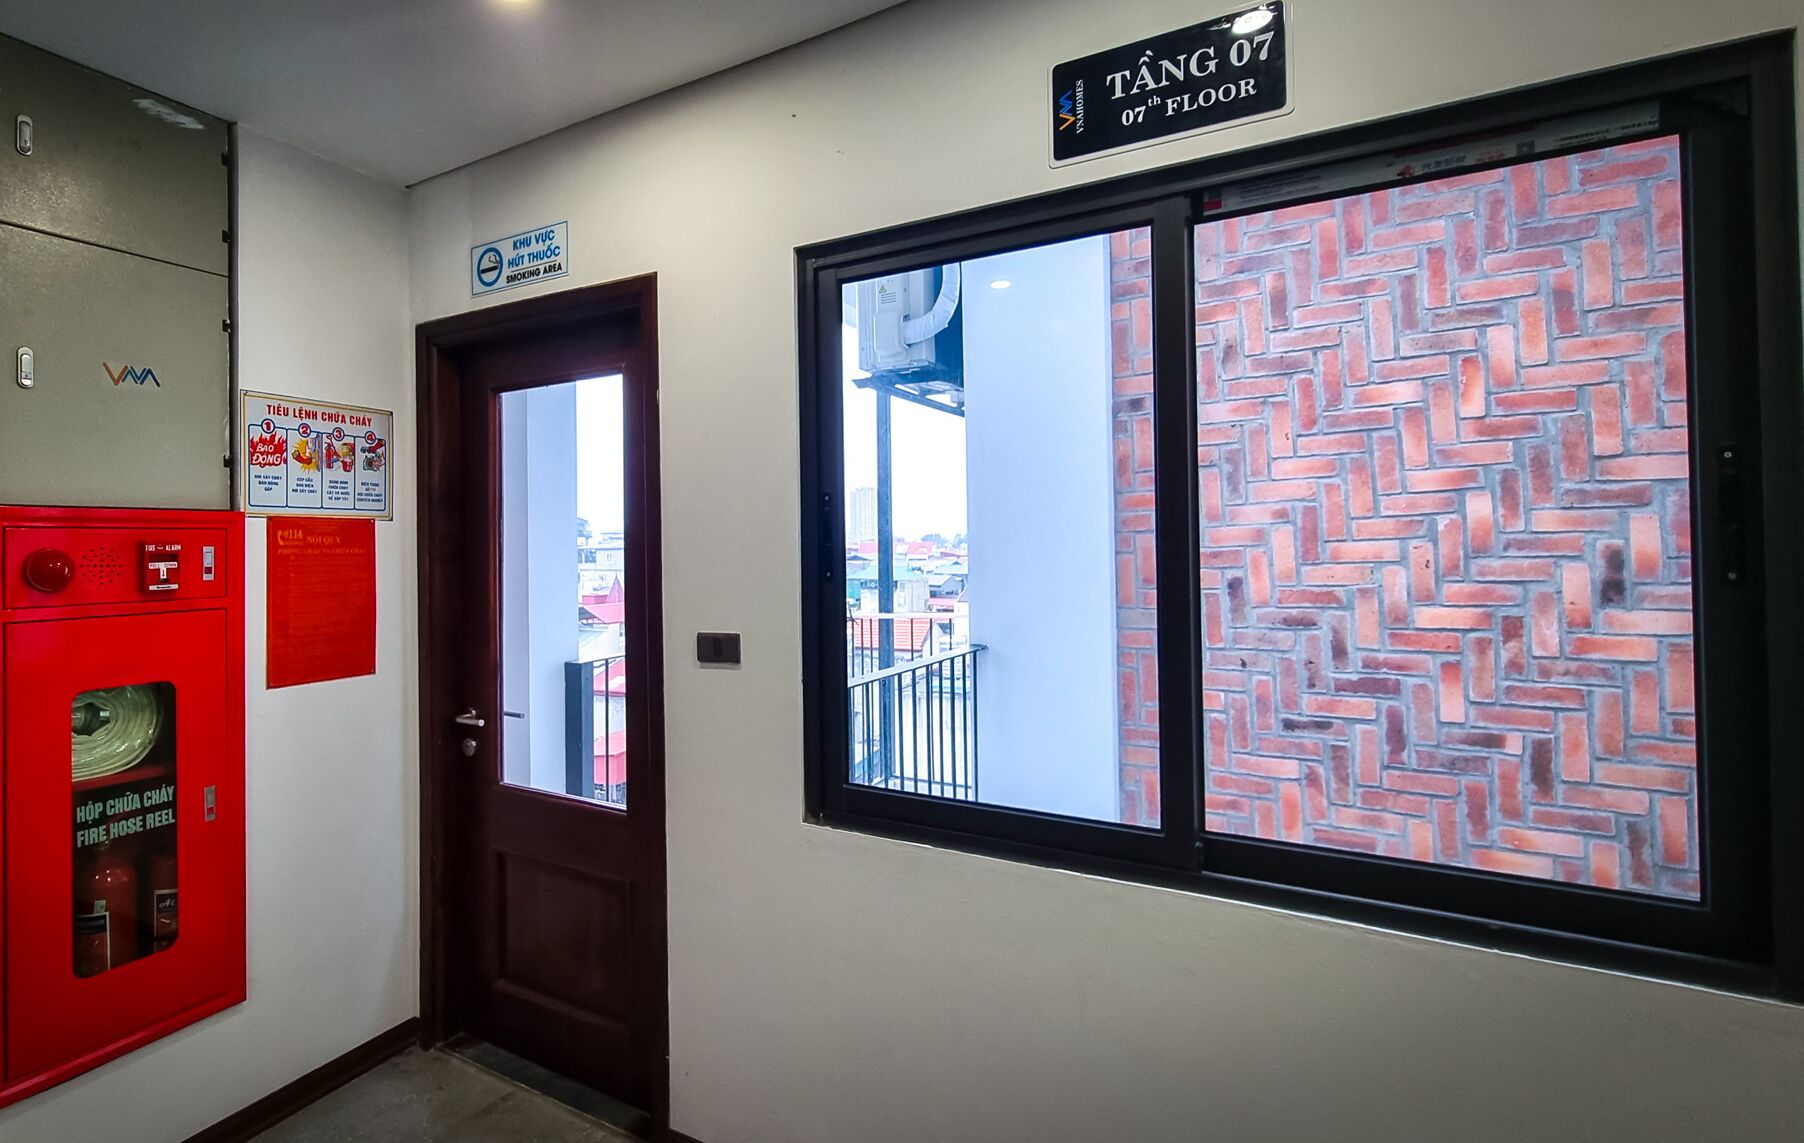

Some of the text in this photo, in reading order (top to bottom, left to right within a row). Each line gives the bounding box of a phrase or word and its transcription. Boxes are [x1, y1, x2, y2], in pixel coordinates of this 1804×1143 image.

[1106, 31, 1275, 99] TẦNG 07
[1121, 78, 1257, 126] 07th FLOOR
[512, 229, 555, 251] KHU VỰC
[507, 243, 561, 269] HÚT THUỐC
[506, 262, 562, 284] SMOKING AREA
[264, 421, 272, 432] 1
[266, 403, 373, 427] TIÊU LỆNH CHỮA CHÁY
[300, 425, 309, 435] 2
[334, 429, 342, 439] 3
[76, 784, 175, 824] HỘP CHỮA CHÁY
[77, 808, 175, 848] FIRE HOSE REEL
